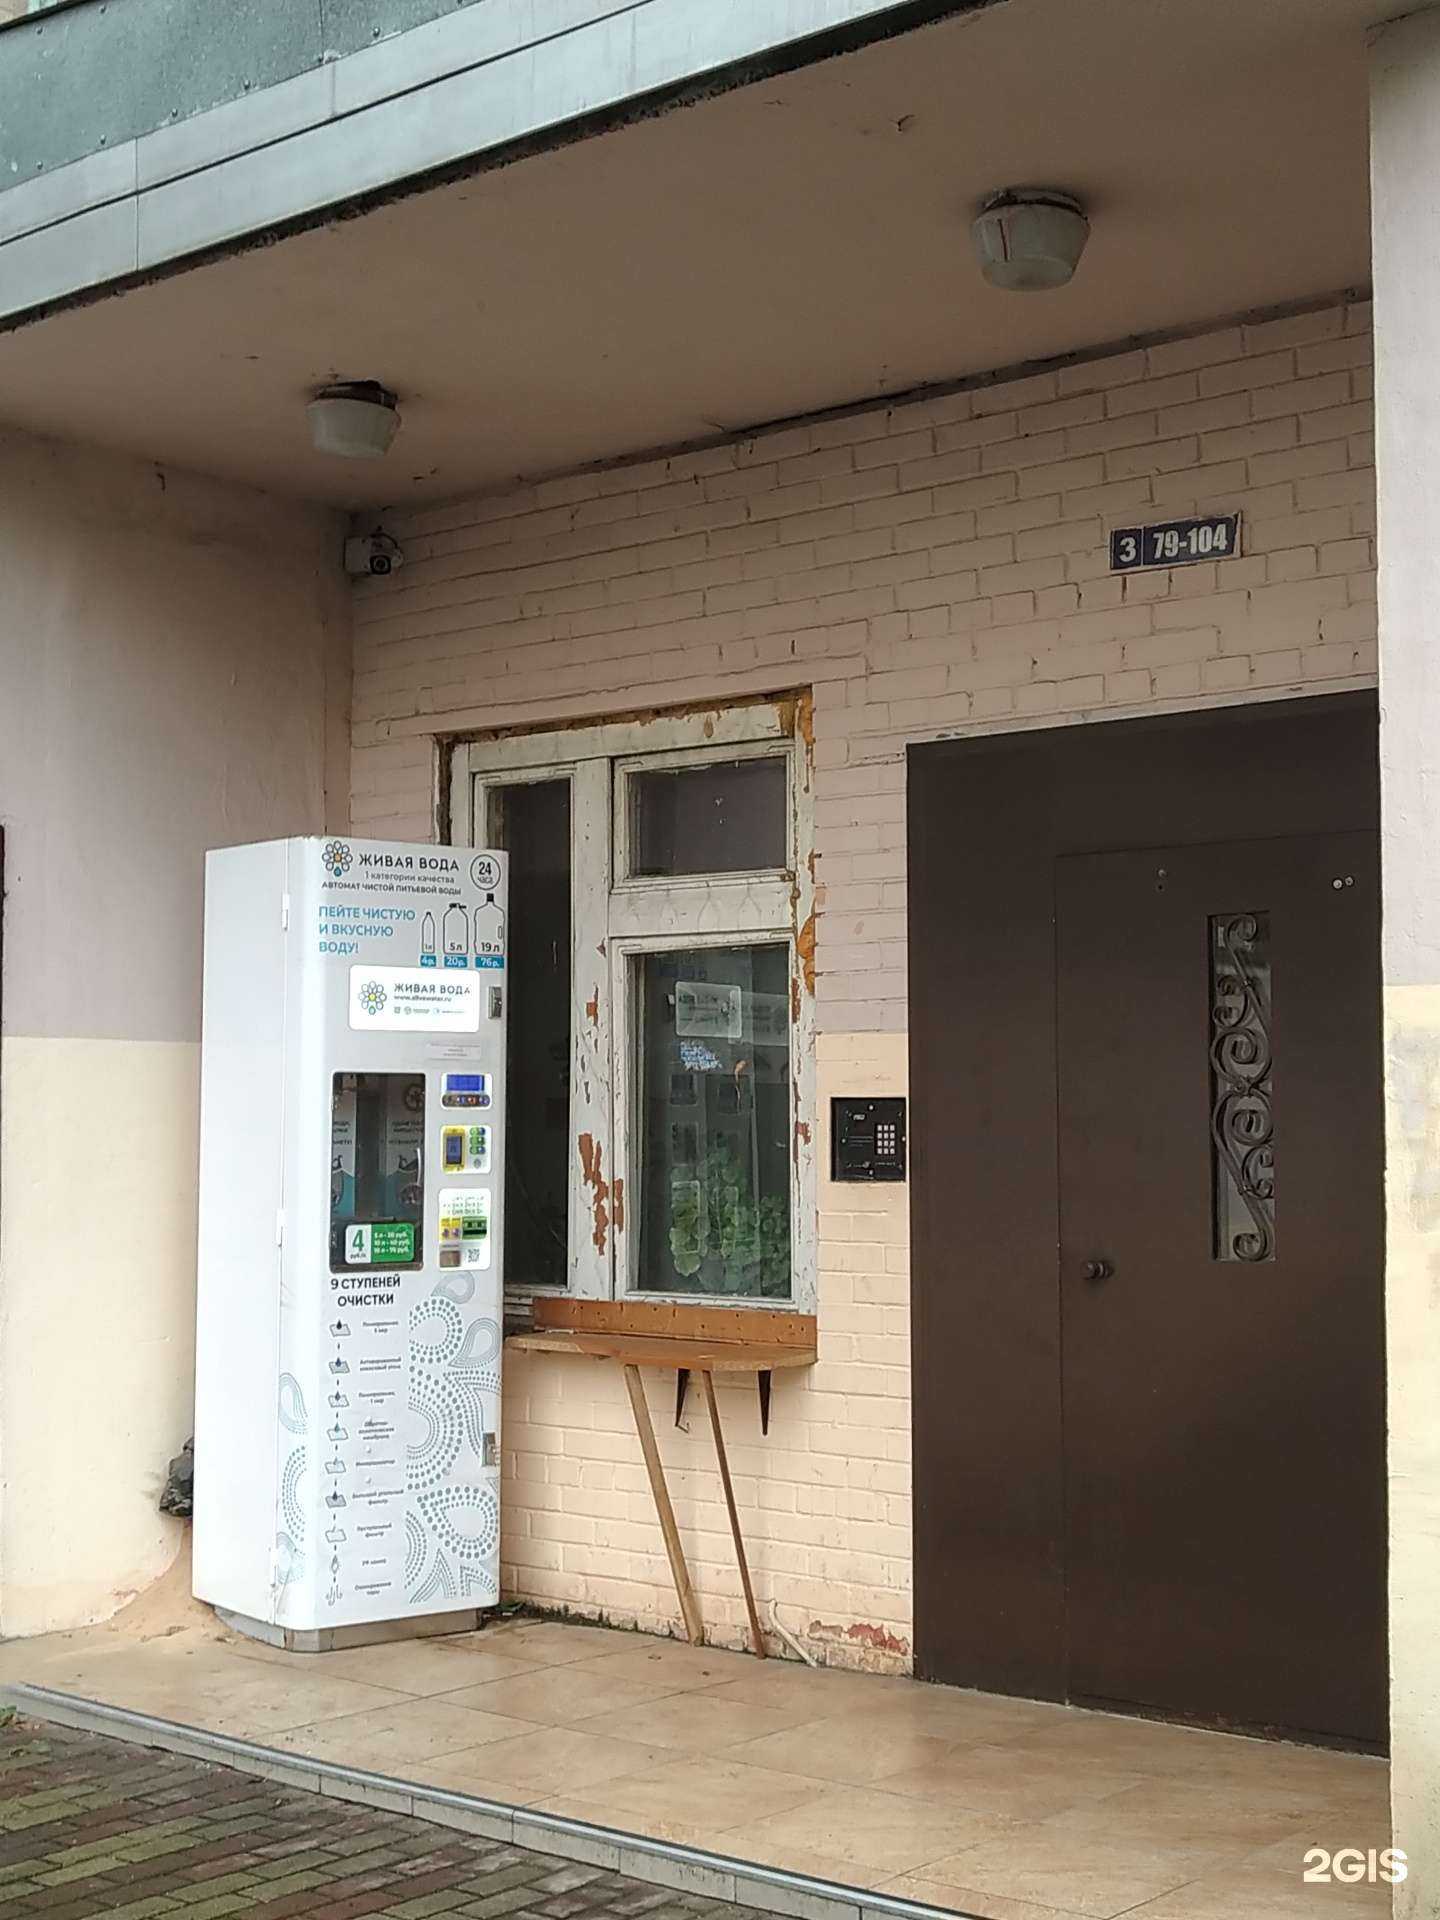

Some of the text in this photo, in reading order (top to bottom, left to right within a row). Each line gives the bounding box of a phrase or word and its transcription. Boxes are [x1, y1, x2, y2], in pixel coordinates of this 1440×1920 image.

[1119, 523, 1228, 563] 3 79-104
[358, 853, 460, 872] ЖИВАЯ ВОДА
[478, 861, 492, 875] 24
[371, 873, 416, 883] категории
[417, 876, 455, 884] качества
[322, 881, 462, 895] АВТОМАТ ЧИСТОЙ ПИТЬЕВОЙ ВОДЫ
[319, 905, 416, 921] ПЕЙТЕ ЧИСТУЮ
[319, 924, 394, 937] И ВКУСНУЮ
[319, 941, 359, 954] ВОДУ!
[481, 942, 492, 952] 19
[394, 983, 470, 995] ЖИВАЯ ВОДА
[352, 1229, 365, 1252] 4
[331, 1273, 401, 1290] 9 СТУПЕНЕЙ
[337, 1293, 394, 1307] ОЧИСТКИ
